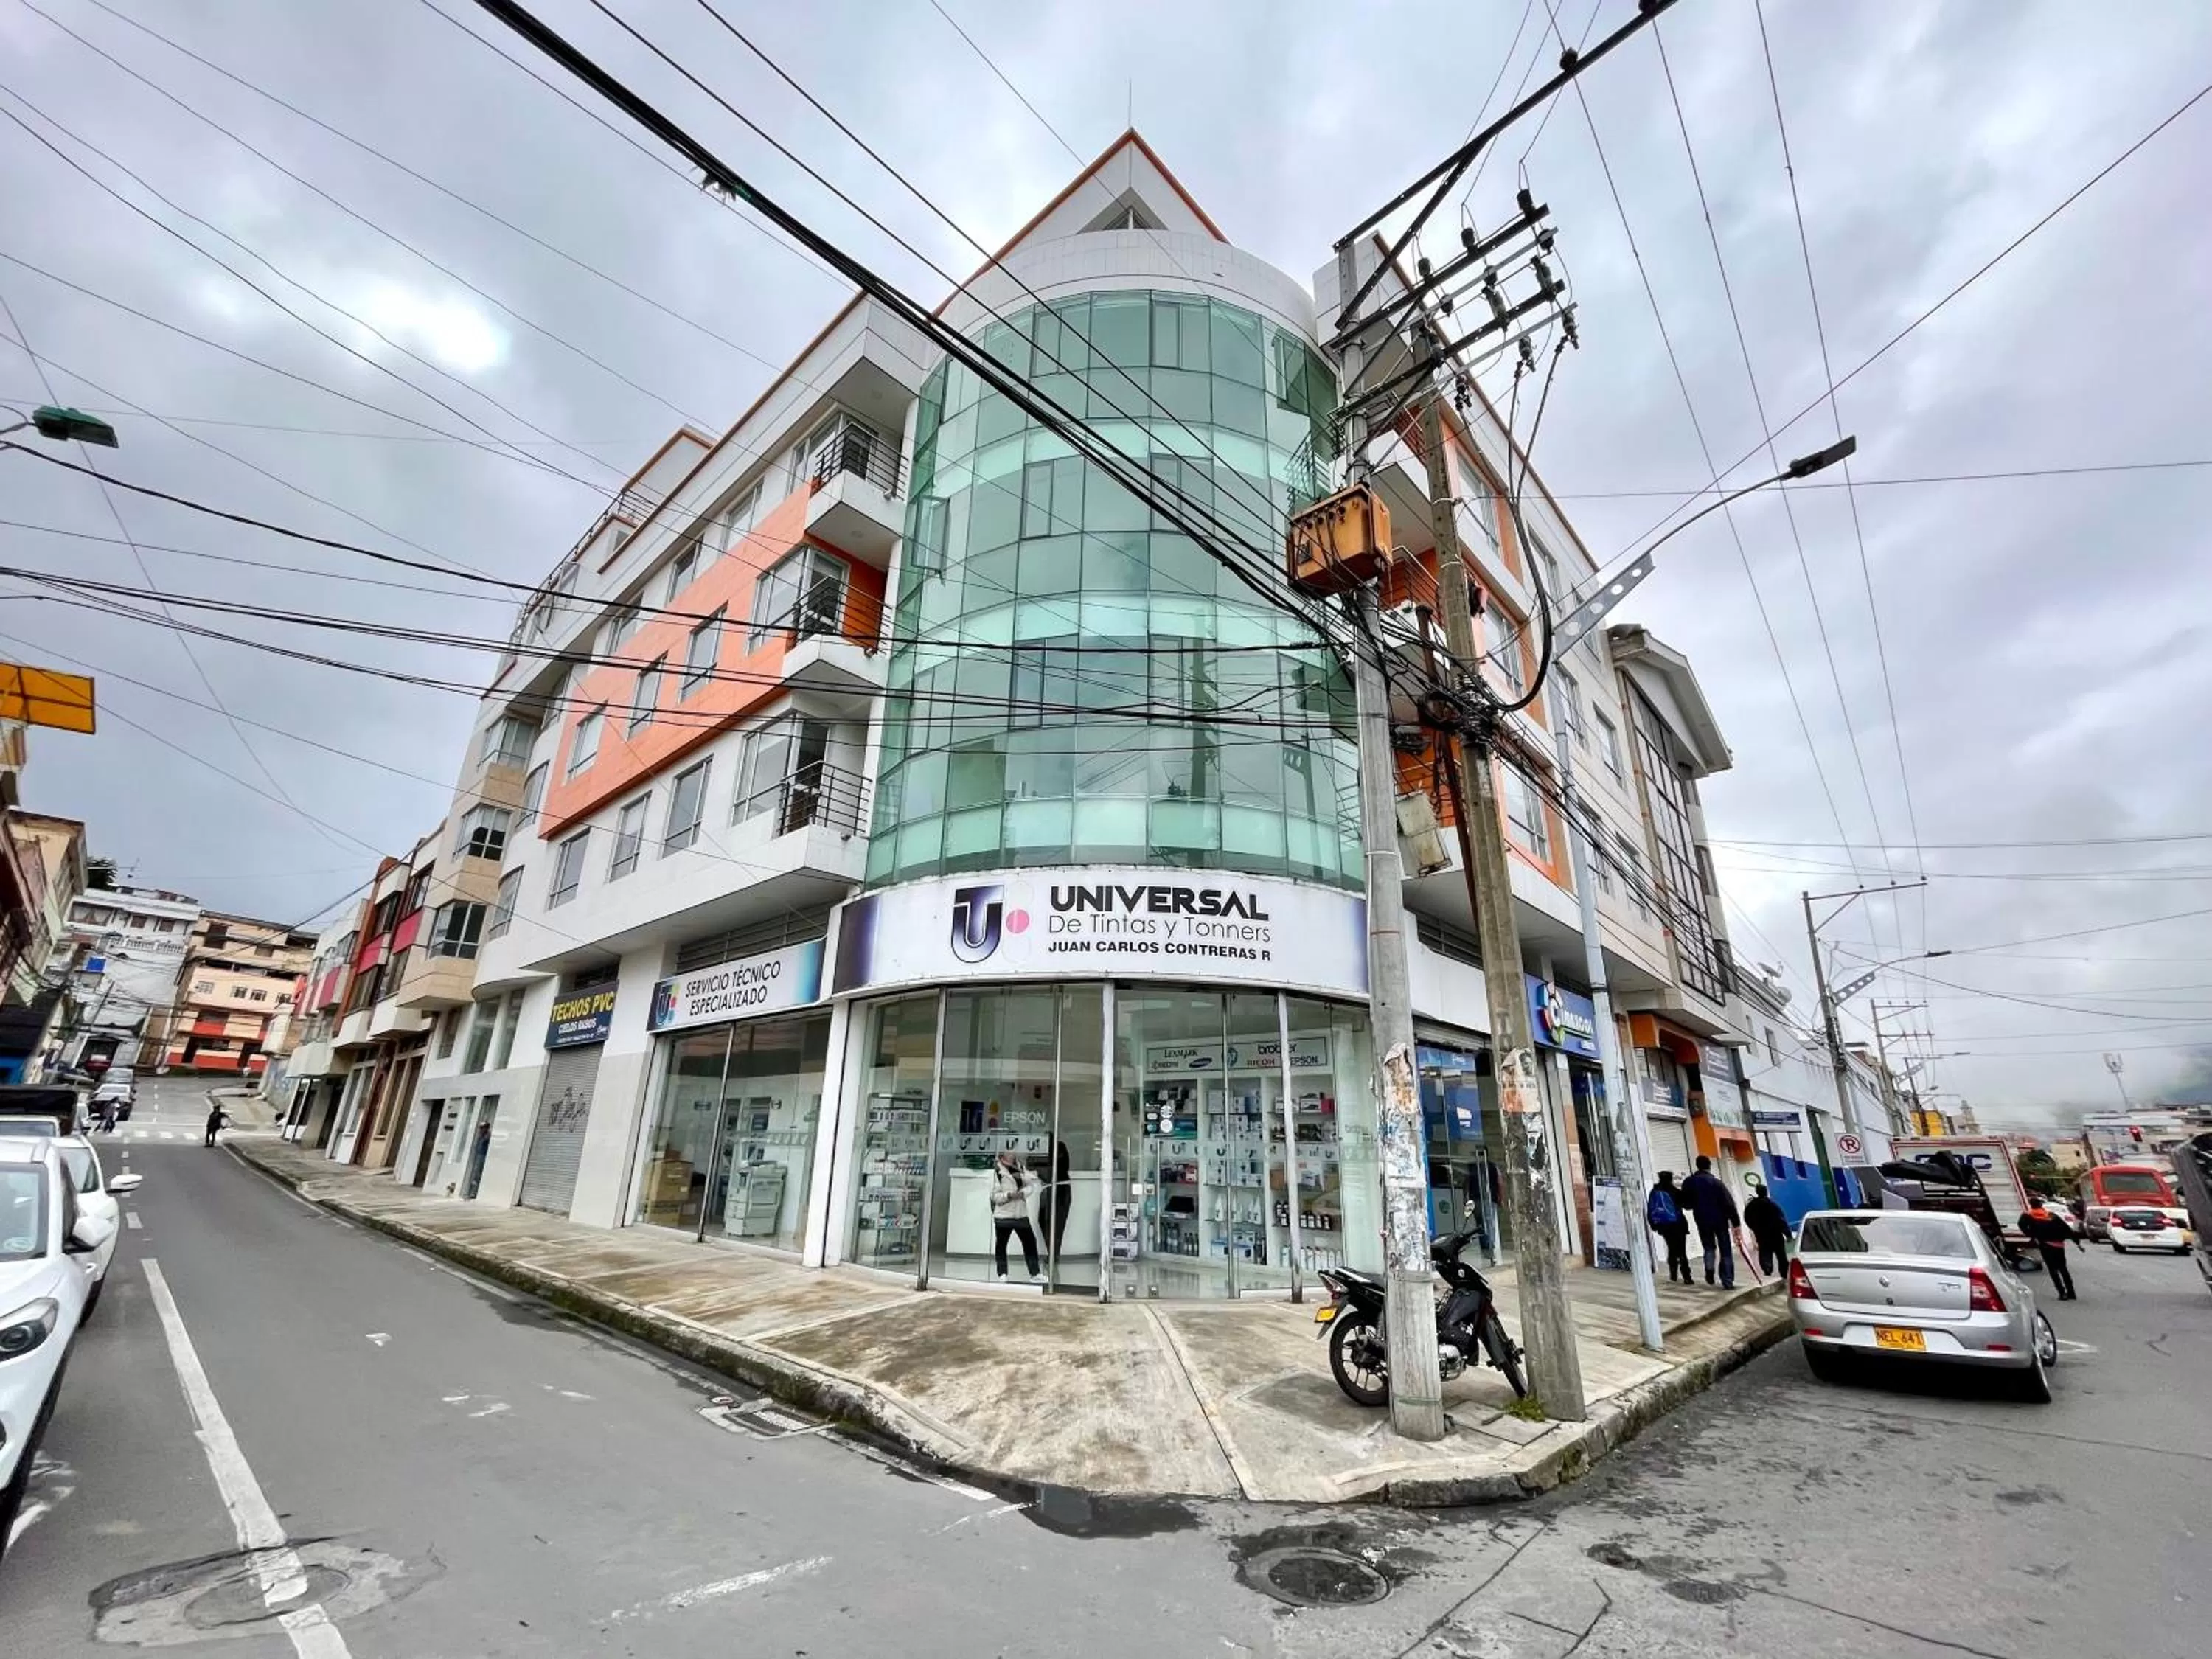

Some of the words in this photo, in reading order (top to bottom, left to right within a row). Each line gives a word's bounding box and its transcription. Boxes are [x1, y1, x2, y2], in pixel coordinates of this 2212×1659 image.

[1051, 886, 1269, 921] UNIVERSAL
[1049, 915, 1082, 933] De
[1090, 914, 1157, 934] Tintas
[1164, 920, 1178, 939] y
[1183, 917, 1270, 943] Tonners
[1048, 941, 1091, 953] JUAN
[1096, 941, 1160, 953] CARLOS
[1165, 942, 1257, 959] CONTRERAS
[1262, 950, 1271, 961] R
[685, 973, 729, 998] SERVICIO
[732, 960, 781, 987] TÉCNICO
[551, 996, 591, 1023] TECHOS
[591, 991, 614, 1014] PVC
[689, 984, 768, 1016] ESPECIALIZADO
[1290, 1055, 1318, 1066] EPSON
[1003, 1111, 1046, 1124] EPSON
